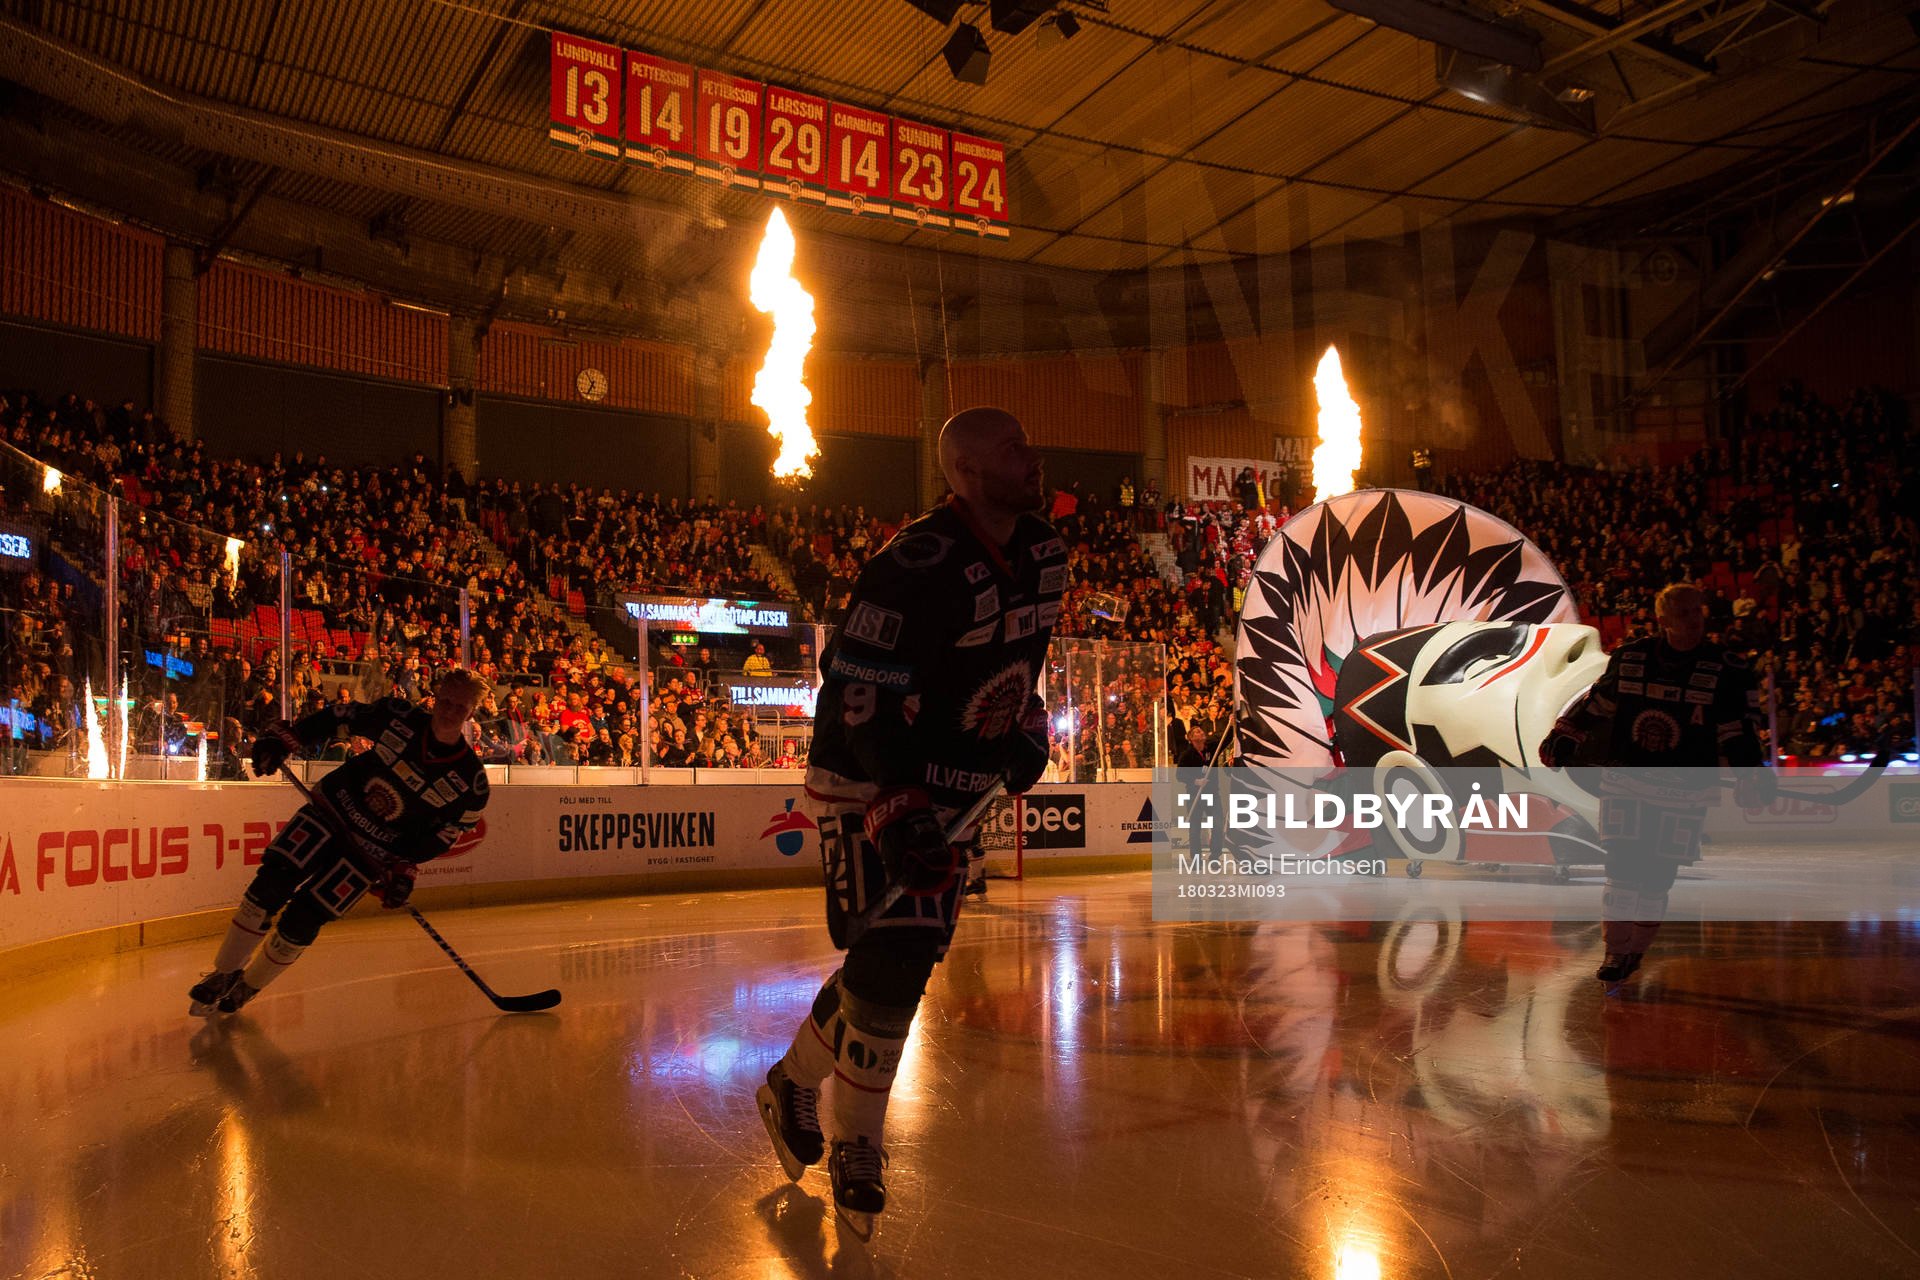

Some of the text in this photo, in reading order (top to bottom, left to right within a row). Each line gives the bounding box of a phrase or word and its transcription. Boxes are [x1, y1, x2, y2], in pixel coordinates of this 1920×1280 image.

[557, 41, 617, 71] LUNDVALL
[631, 61, 690, 89] PETTERSSON
[566, 66, 609, 125] 13
[640, 85, 684, 142] 14
[702, 80, 758, 106] PETTERSSON
[770, 94, 824, 122] LARSSON
[709, 103, 750, 159] 19
[834, 112, 885, 137] CARNBÄCK
[898, 126, 944, 151] SUNDIN
[769, 117, 821, 175] 29
[840, 134, 880, 188] 14
[899, 148, 944, 201] 23
[958, 160, 1004, 212] 24
[559, 795, 613, 805] FÖLJ MED TILL
[559, 811, 715, 852] SKEPPSVIKEN
[36, 826, 189, 892] FOCUS
[675, 856, 715, 864] FASTIGHET
